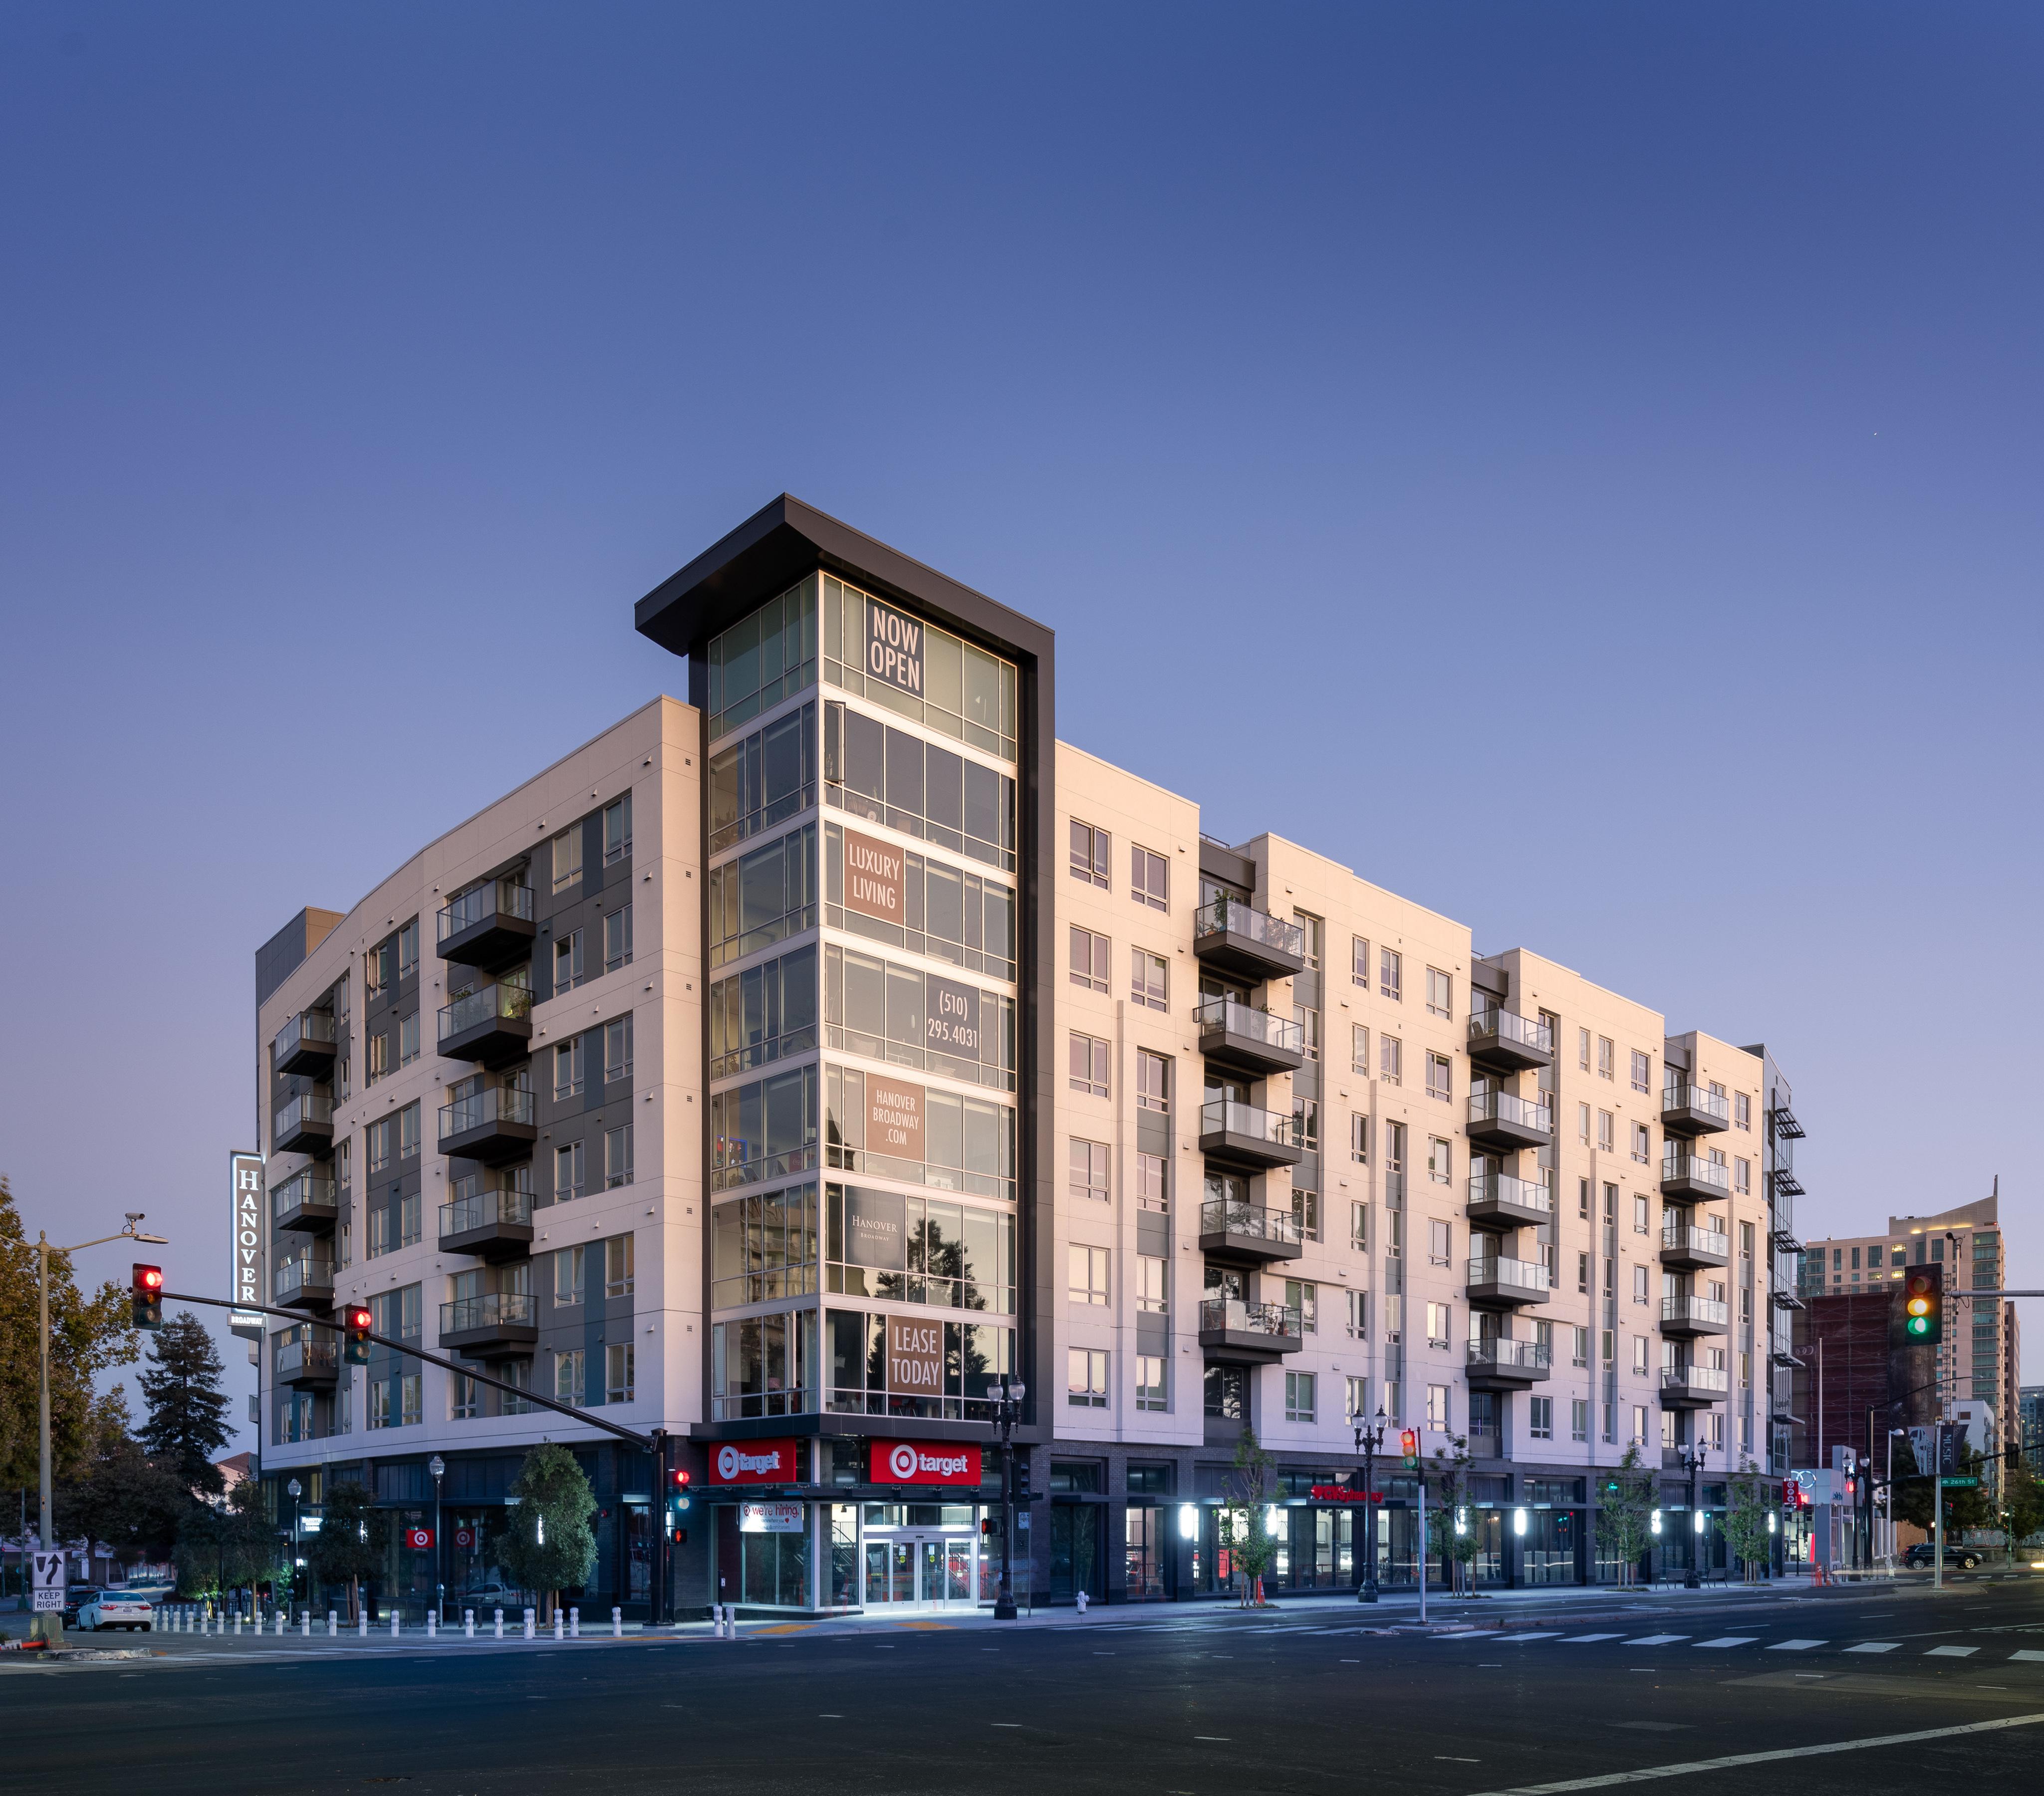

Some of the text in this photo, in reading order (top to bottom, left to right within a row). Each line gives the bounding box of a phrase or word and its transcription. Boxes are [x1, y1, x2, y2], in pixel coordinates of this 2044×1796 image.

[872, 606, 919, 656] NOW
[871, 641, 920, 691] OPEN
[849, 843, 900, 881] LUXURY
[853, 876, 896, 909] LIVING
[939, 990, 968, 1021] (510)
[928, 1018, 977, 1048] 295.4031
[876, 1089, 916, 1112] HANOVER
[873, 1107, 919, 1130] BROADWAY
[885, 1128, 907, 1145] .COM
[240, 1170, 258, 1301] HANOVER
[852, 1215, 897, 1233] HANOVER
[231, 1316, 263, 1325] BROADWAY
[895, 1326, 937, 1354] LEASE
[891, 1357, 940, 1385] TODAY
[740, 1451, 779, 1474] target
[1942, 1434, 1952, 1465] MUSIC
[919, 1453, 968, 1476] target
[752, 1505, 773, 1516] we're
